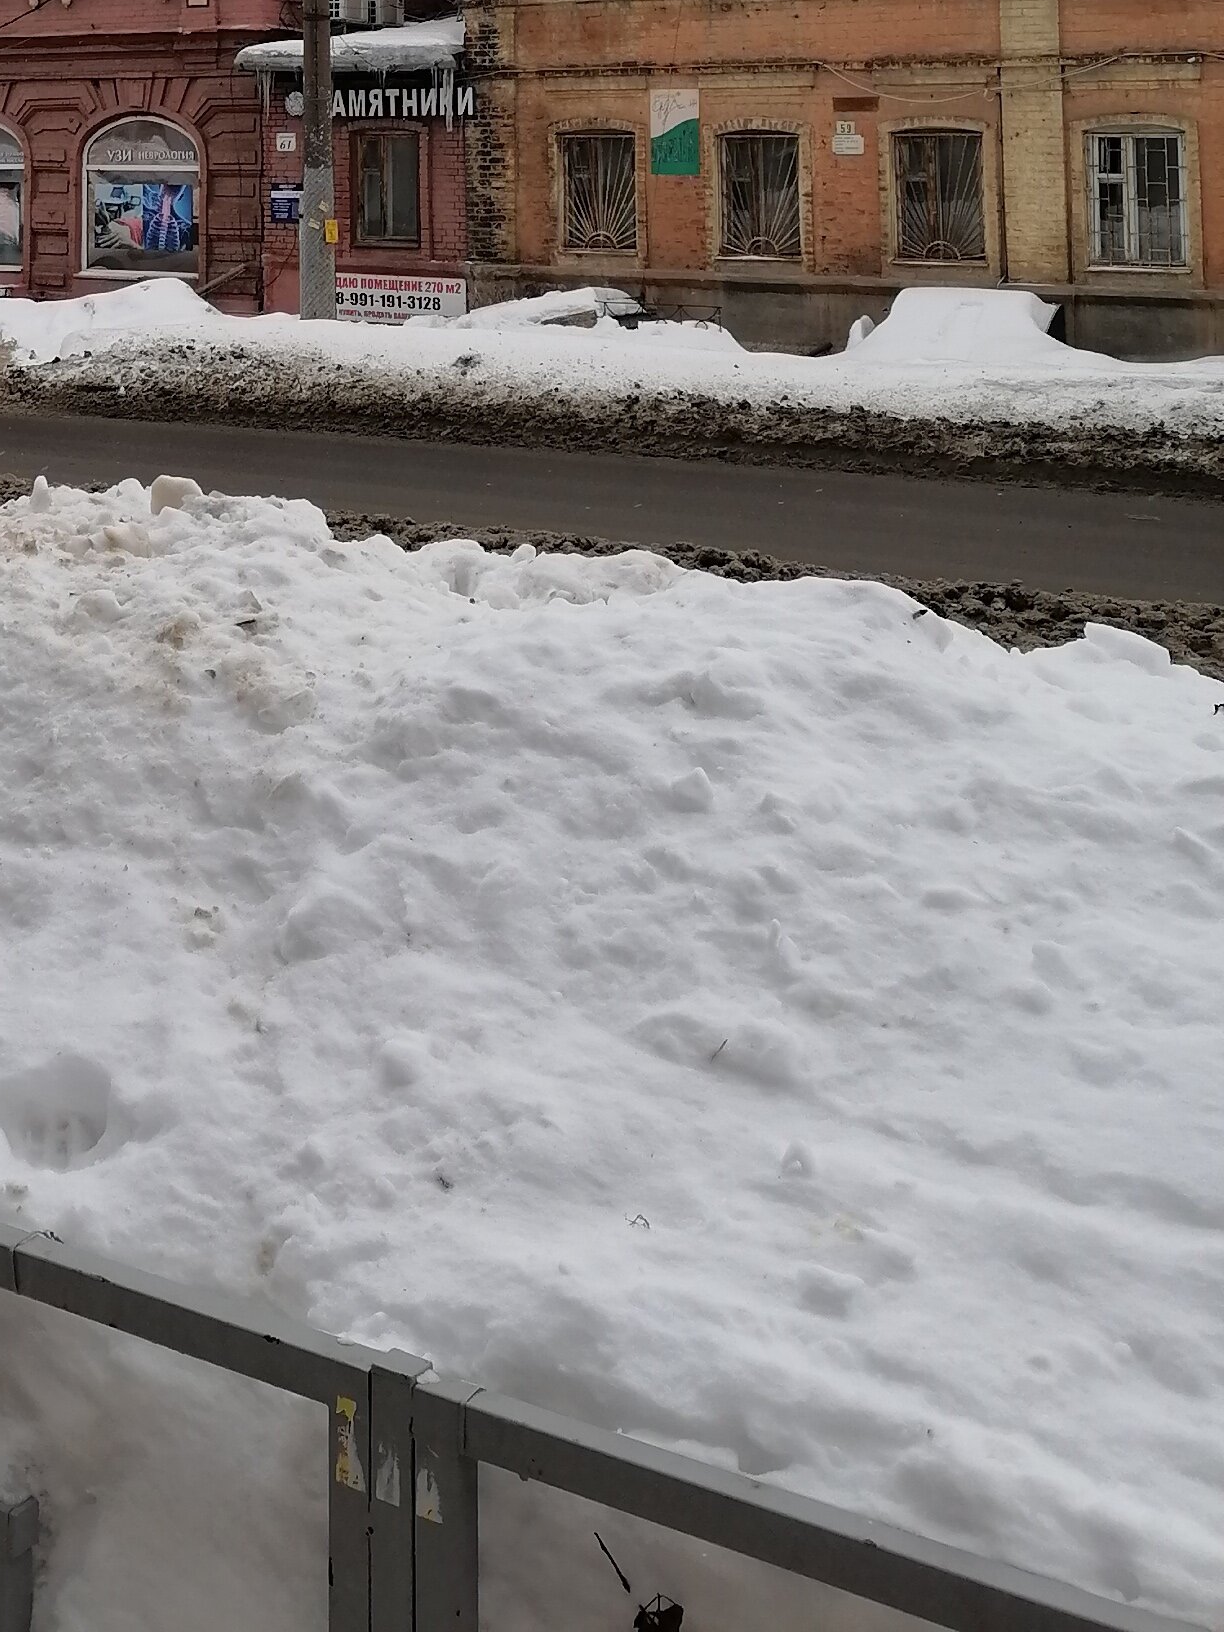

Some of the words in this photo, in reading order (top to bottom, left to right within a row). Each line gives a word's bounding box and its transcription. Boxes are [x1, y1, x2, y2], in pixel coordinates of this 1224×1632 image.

[332, 86, 474, 117] АМЯТНИКИ
[840, 123, 852, 134] 59
[279, 140, 292, 150] 61
[107, 149, 133, 162] УЗИ
[138, 150, 195, 161] НЕВРОЛОГИЯ
[360, 278, 423, 294] ПОМЕЩЕНИЕ
[424, 281, 443, 294] 270
[336, 292, 441, 311] 8-991-191-3128
